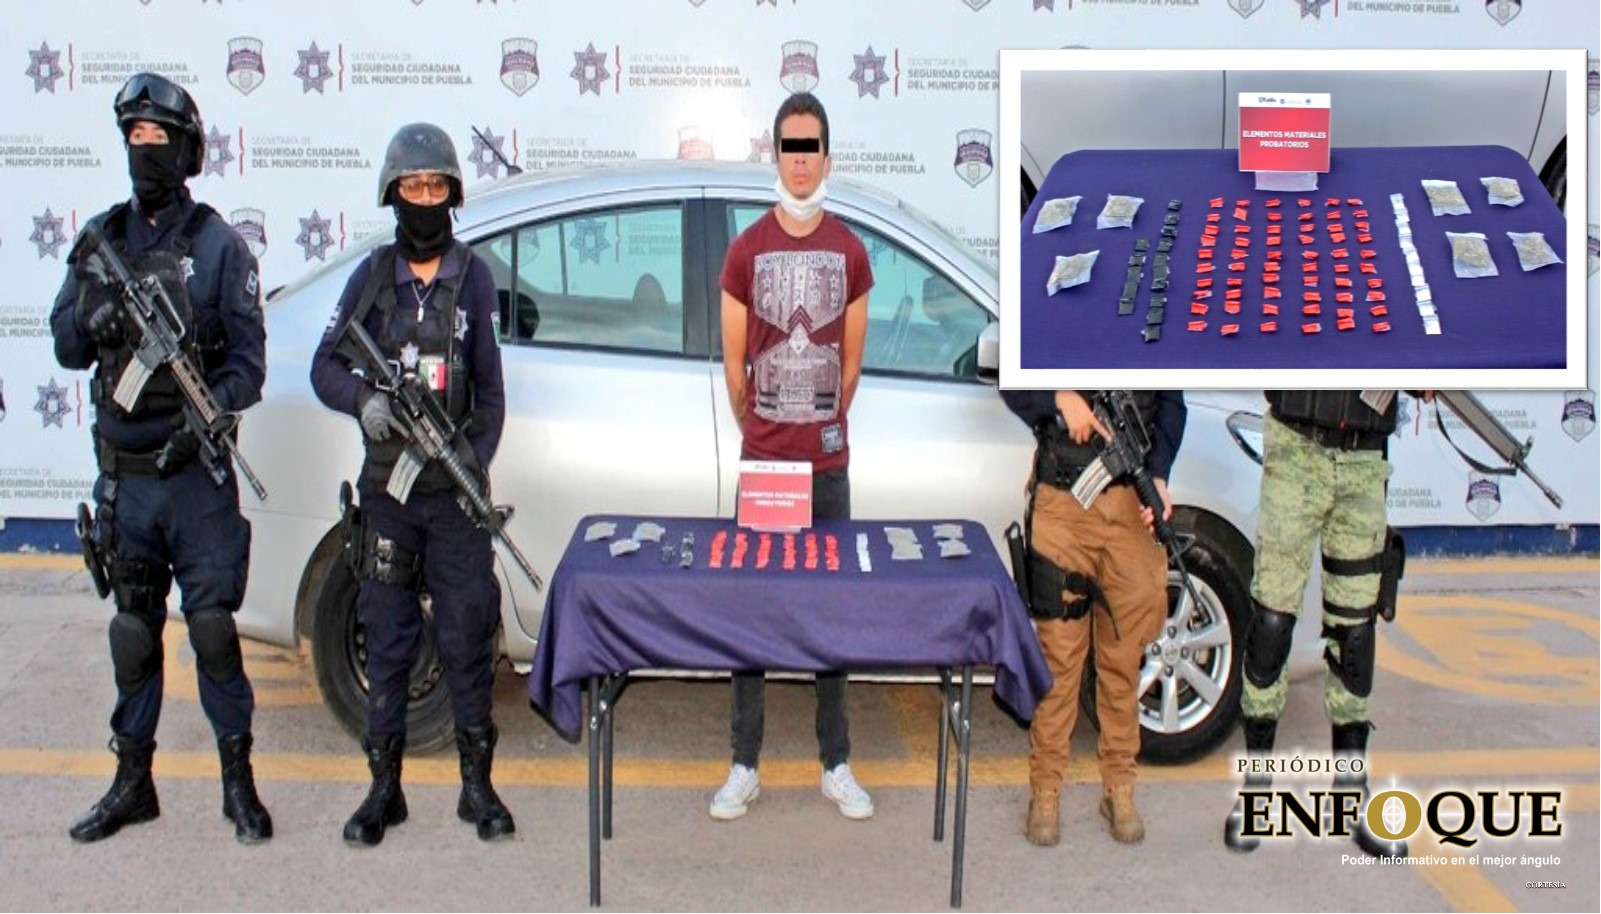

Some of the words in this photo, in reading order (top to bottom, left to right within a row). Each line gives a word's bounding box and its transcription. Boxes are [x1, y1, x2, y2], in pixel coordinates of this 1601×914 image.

[81, 63, 132, 72] SEGURIDAD
[134, 63, 188, 73] CIUDADANA
[351, 63, 404, 73] SEGURIDAD
[406, 64, 461, 73] CIUDADANA
[629, 65, 682, 74] SEGURIDAD
[684, 66, 740, 75] CIUDADANA
[907, 69, 960, 78] SEGURIDAD
[963, 70, 1000, 79] CIUDAD
[82, 75, 98, 84] DEL
[169, 75, 200, 84] UEBLA
[351, 75, 369, 84] DEL
[372, 75, 419, 84] MUNICIPIO
[421, 76, 434, 85] DE
[436, 76, 472, 85] PUEBLA
[629, 77, 646, 86] DEL
[649, 77, 697, 87] MUNICIPIO
[700, 78, 712, 86] DE
[715, 78, 751, 87] PUEBLA
[907, 80, 924, 90] DEL
[928, 81, 975, 90] MUNICIPIO
[978, 81, 990, 90] DE
[1243, 130, 1283, 138] ELEMENTOS
[1284, 131, 1327, 139] MATERIALES
[1260, 140, 1309, 149] PROBATORIOS
[0, 147, 36, 156] GURIDAD
[38, 147, 91, 156] CIUDADANA
[252, 148, 303, 157] SEGURIDAD
[306, 148, 360, 157] CIUDADANA
[526, 149, 578, 159] SEGURIDAD
[581, 150, 637, 160] CIUDADANA
[860, 153, 915, 162] CIUDADANA
[5, 158, 50, 167] MUNICIPIO
[53, 158, 65, 167] DE
[67, 159, 101, 168] PUEBLA
[252, 159, 269, 168] DEL
[272, 159, 319, 168] MUNICIPIO
[321, 160, 333, 168] DE
[336, 160, 371, 169] PUEBLA
[526, 161, 543, 170] DEL
[832, 164, 873, 173] UNICIPIO
[875, 165, 887, 173] DE
[890, 165, 925, 174] PUEBLA
[0, 479, 45, 489] EGURIDAD
[47, 479, 92, 489] CIUDADAN
[14, 489, 59, 499] MUNICIPIO
